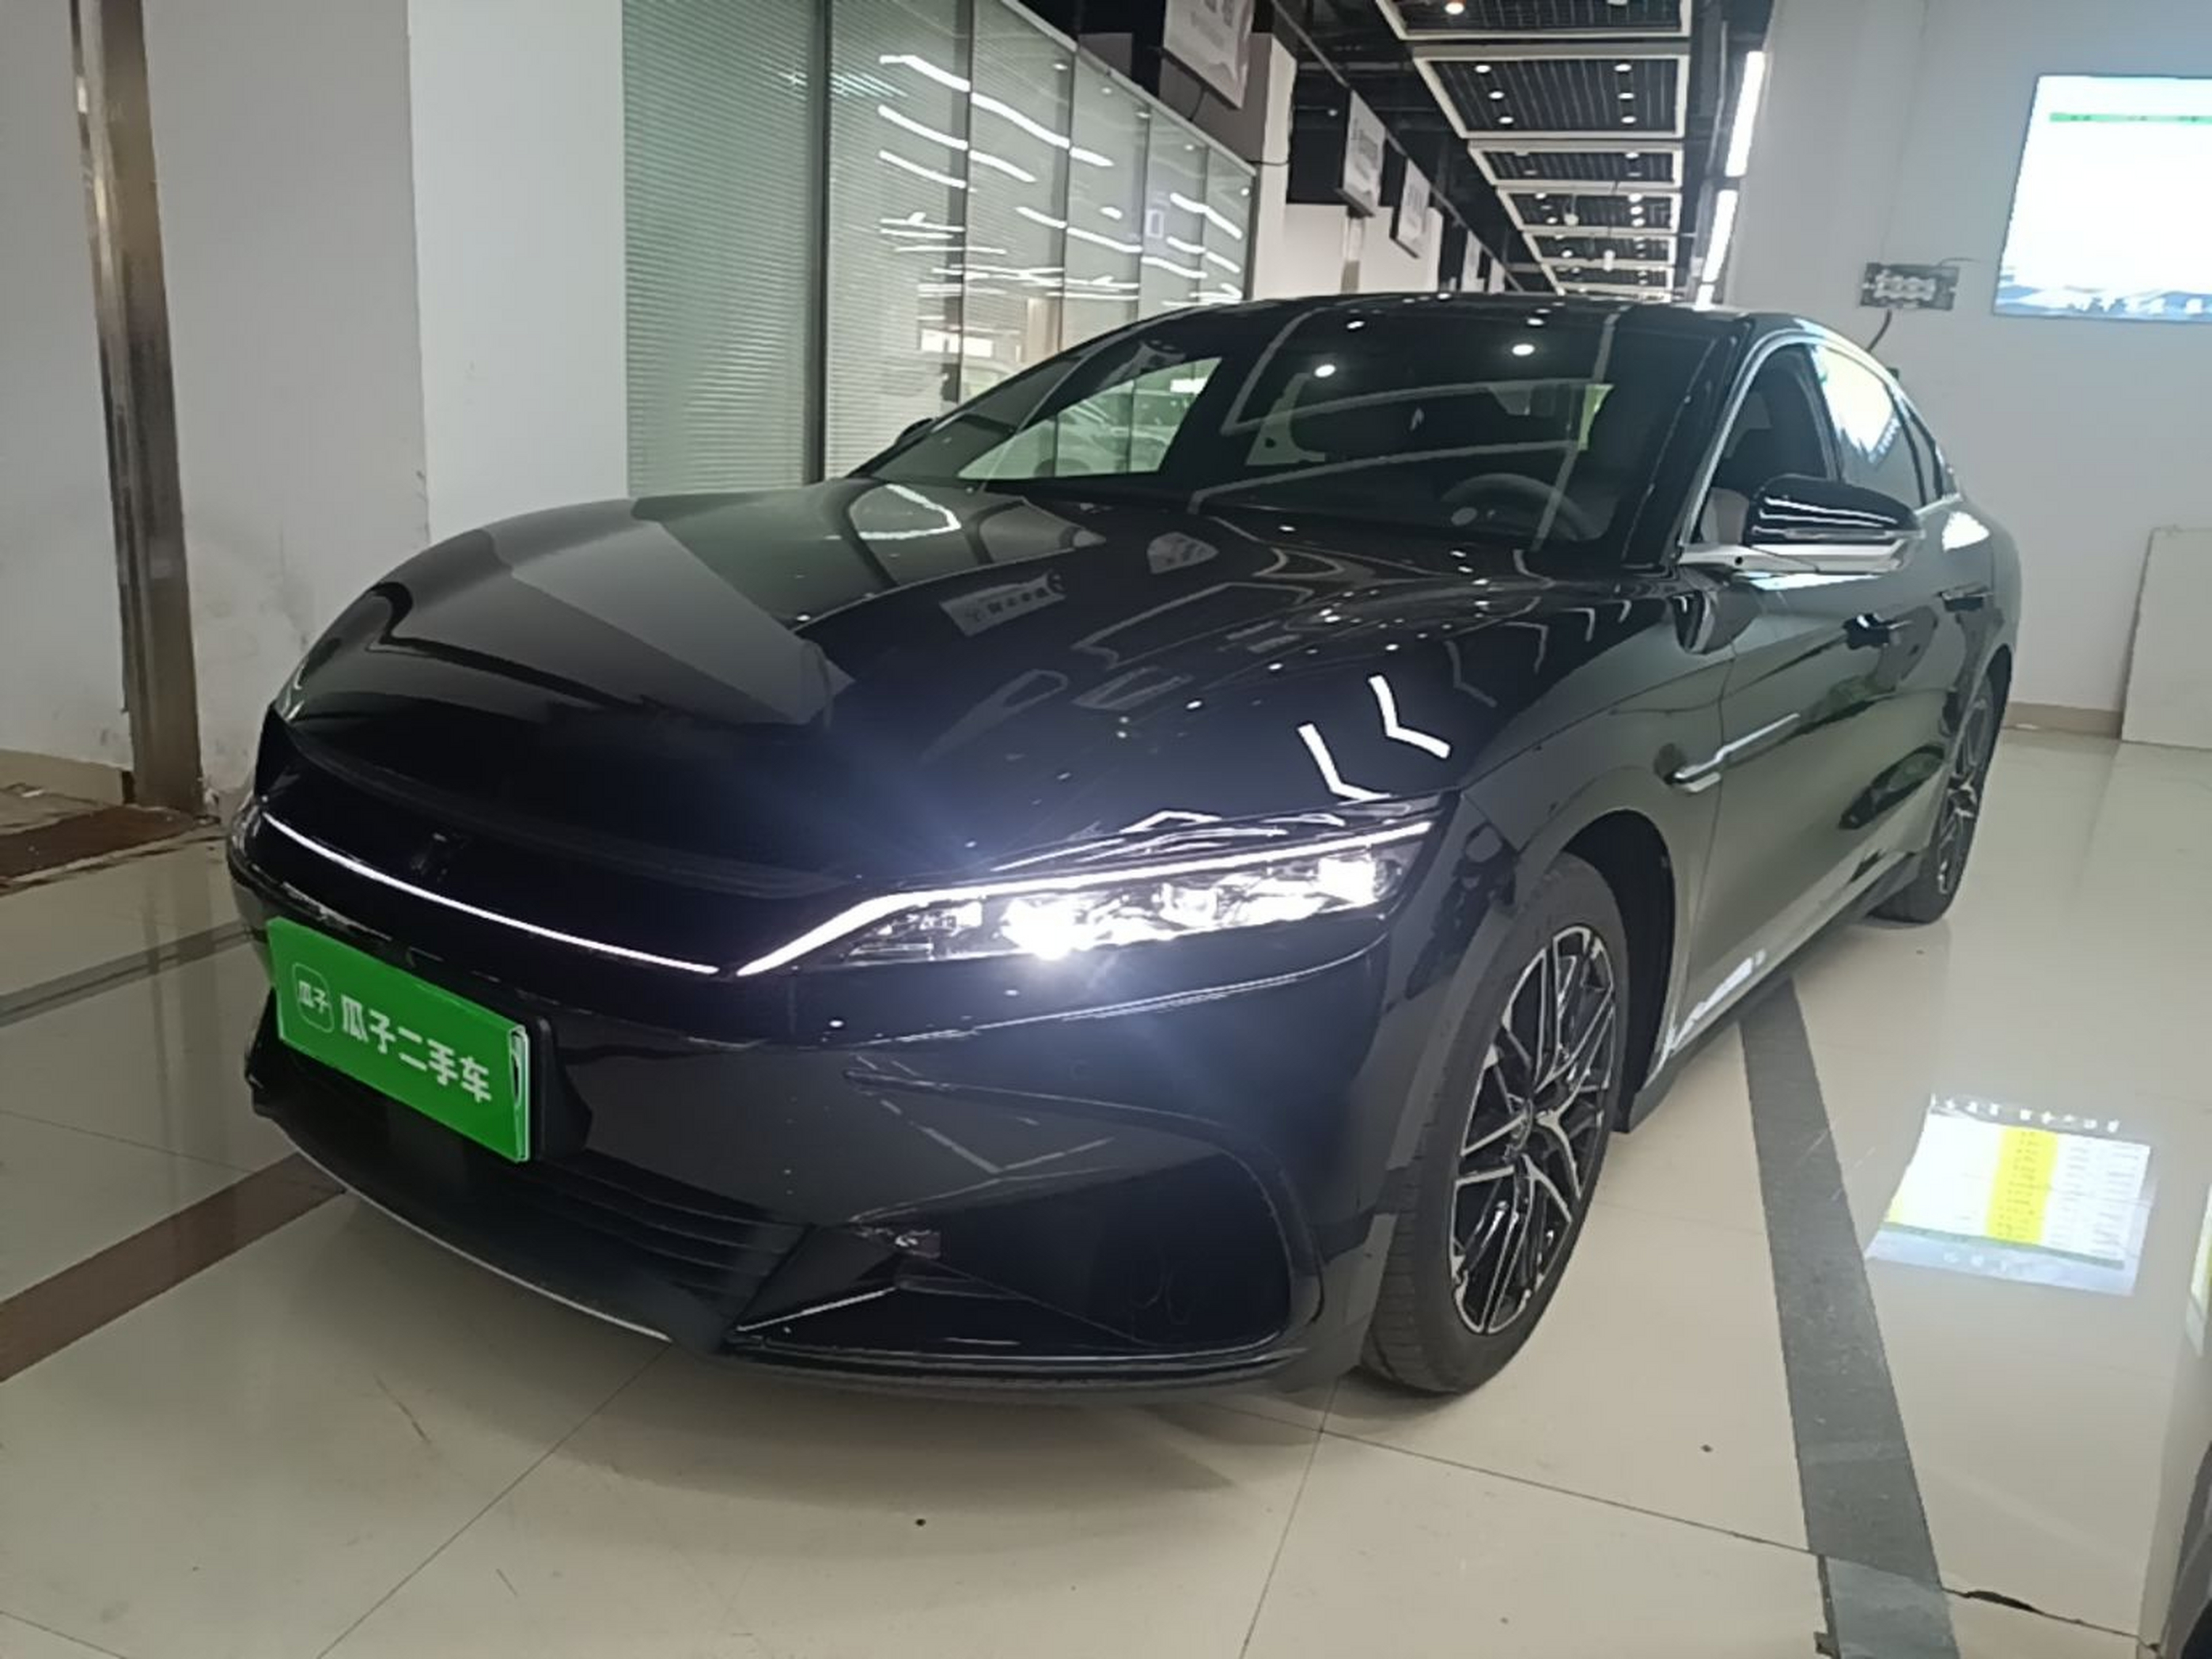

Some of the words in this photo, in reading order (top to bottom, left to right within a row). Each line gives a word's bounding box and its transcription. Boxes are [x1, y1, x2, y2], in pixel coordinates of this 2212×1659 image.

[297, 980, 329, 1013] 瓜子
[340, 994, 493, 1103] 瓜子二手车
